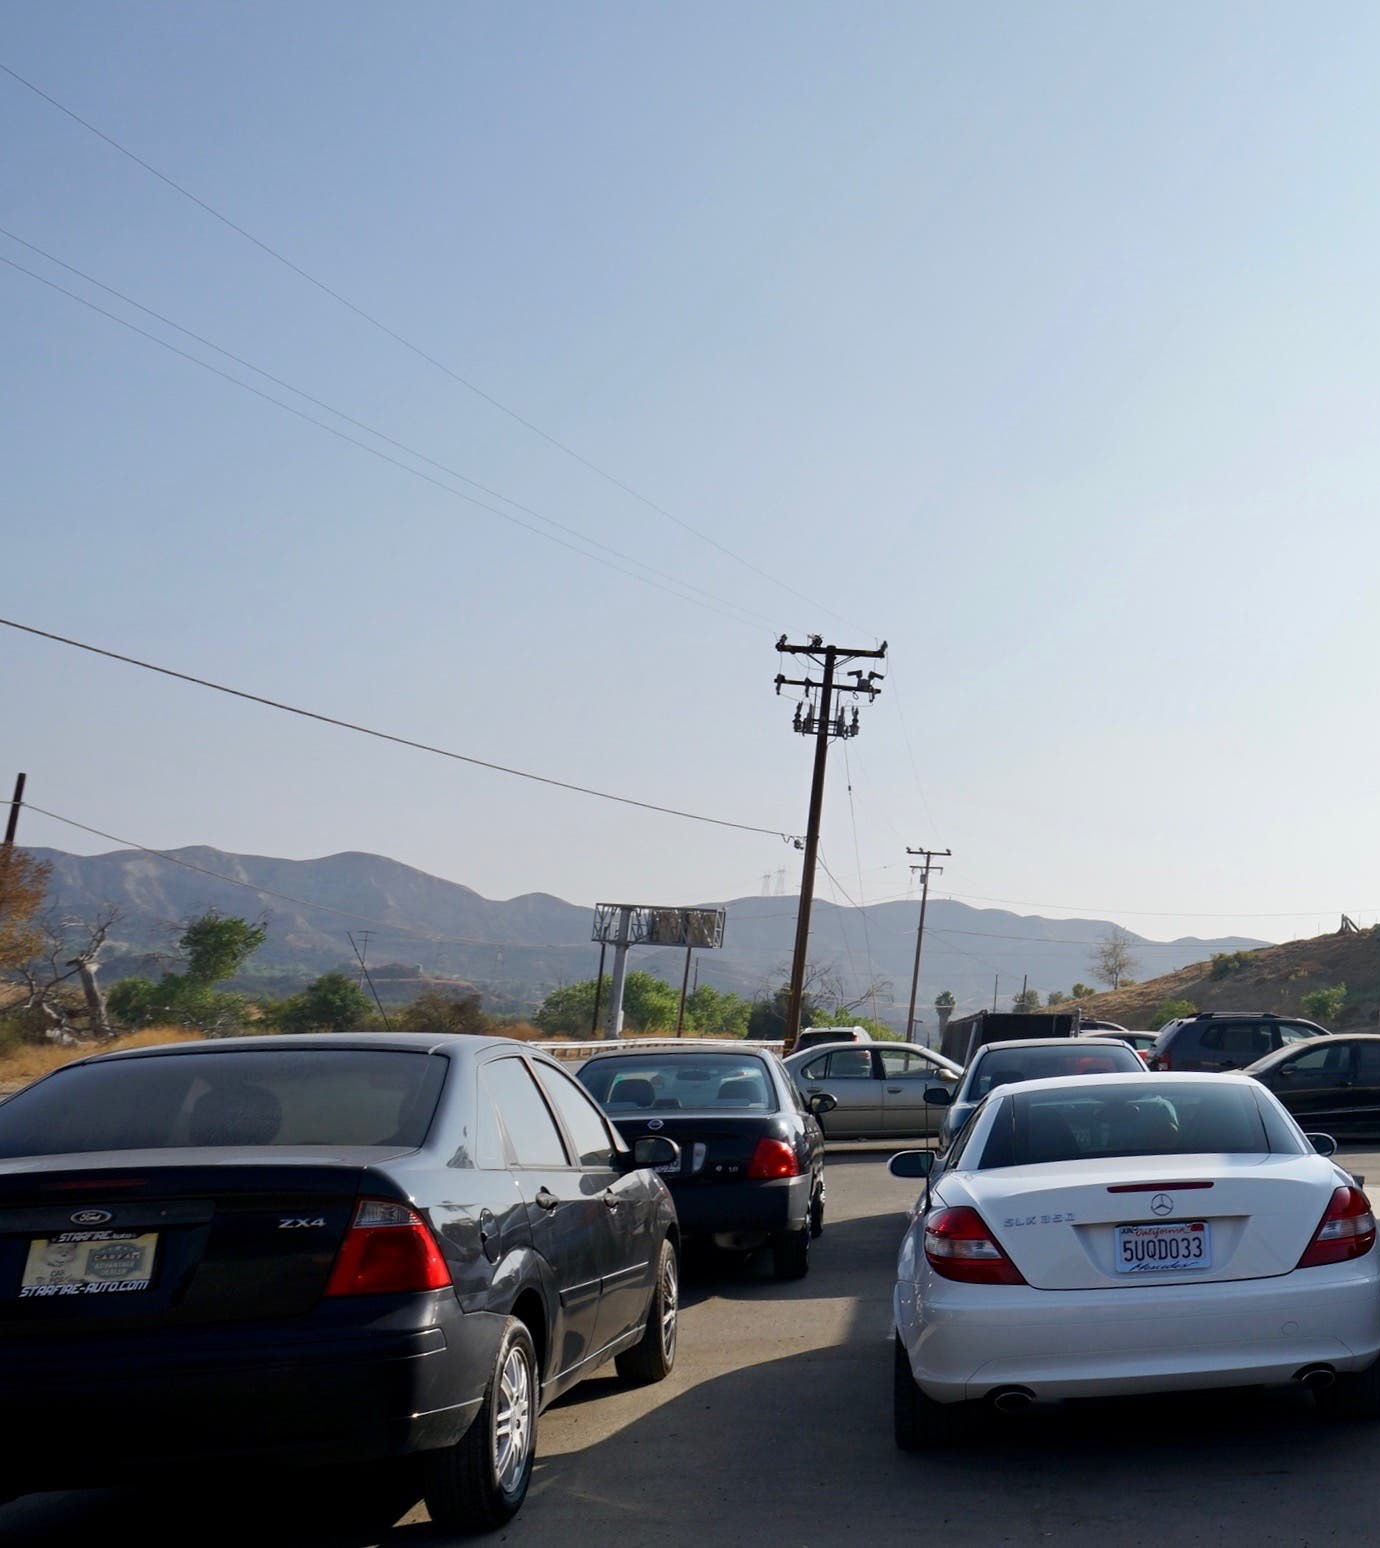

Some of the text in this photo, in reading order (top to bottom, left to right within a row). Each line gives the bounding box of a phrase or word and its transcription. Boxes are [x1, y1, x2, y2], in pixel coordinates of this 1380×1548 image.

[278, 1217, 328, 1229] ZX4
[1003, 1215, 1037, 1228] SLK
[58, 1230, 114, 1243] STARFIRE
[1135, 1227, 1185, 1239] California
[1122, 1237, 1204, 1263] 5UQD033
[18, 1280, 149, 1298] STARFIRE-AUTO.COM
